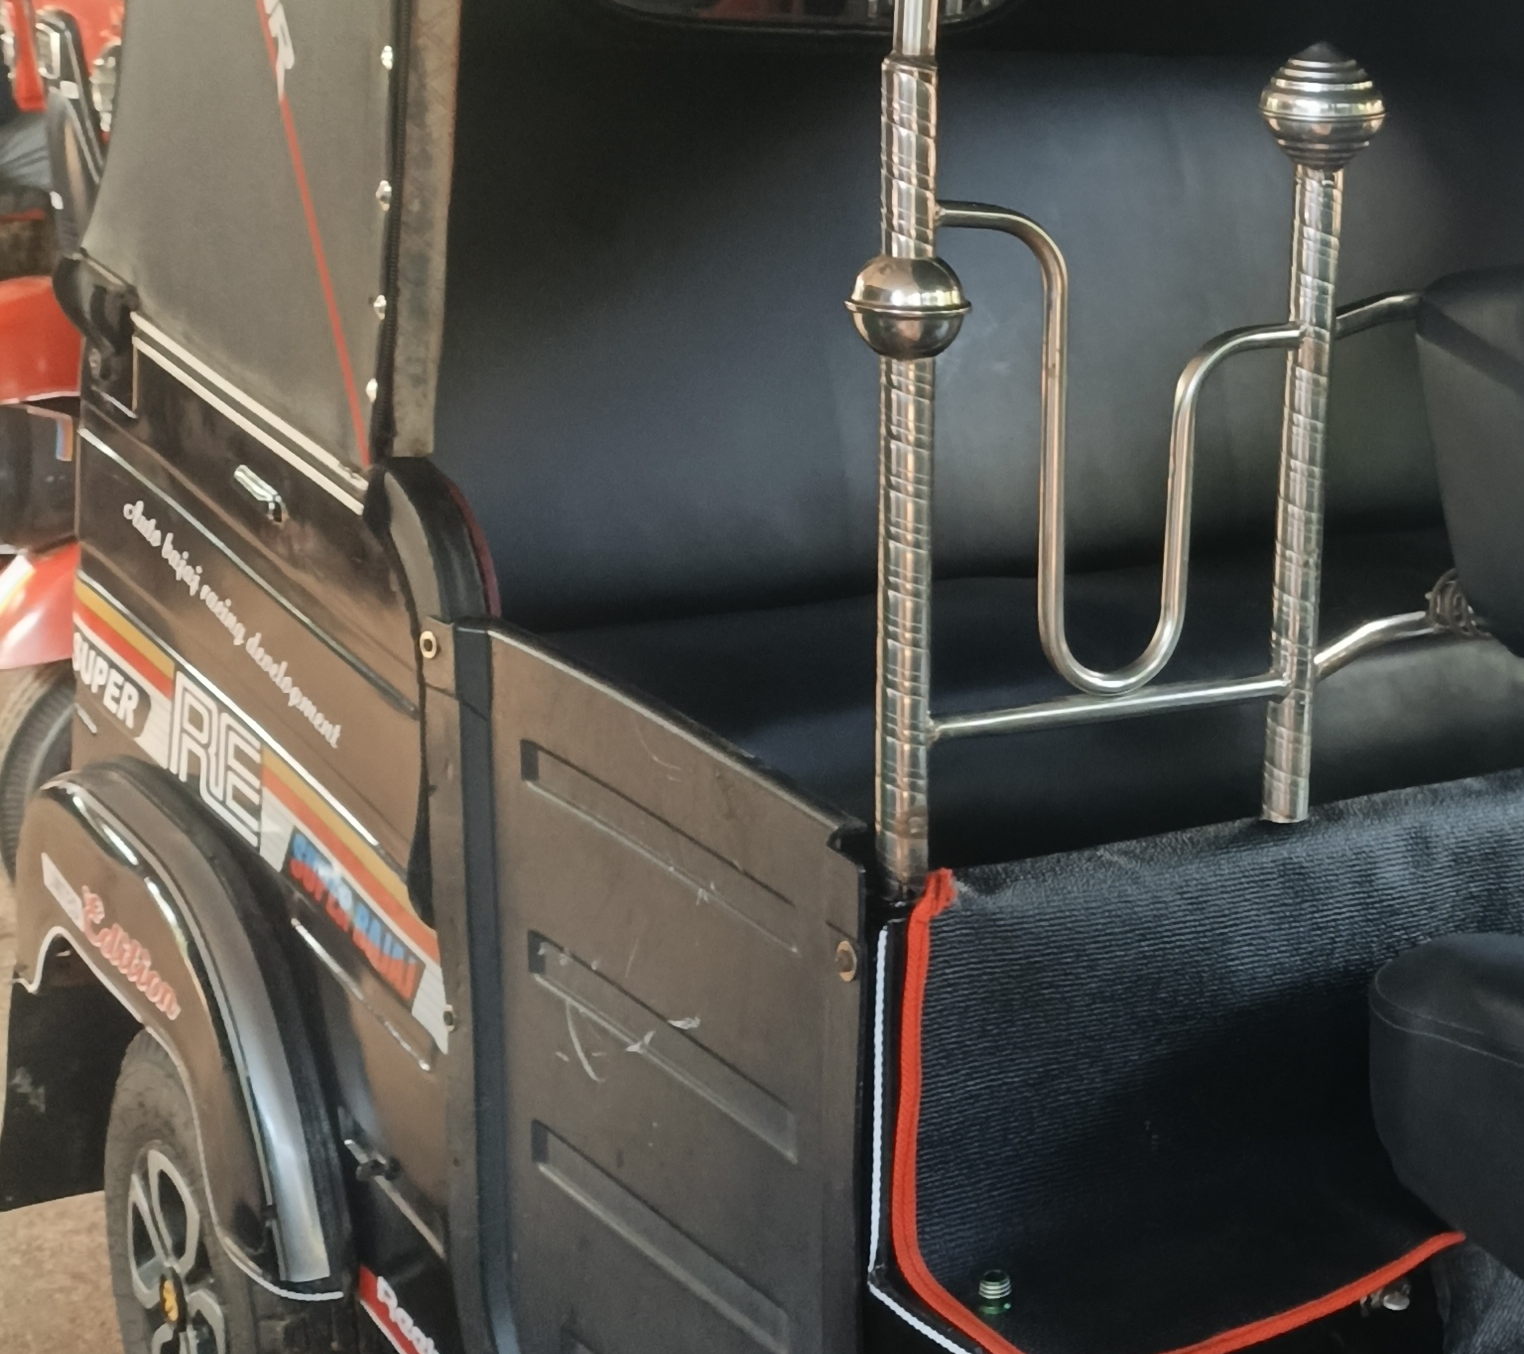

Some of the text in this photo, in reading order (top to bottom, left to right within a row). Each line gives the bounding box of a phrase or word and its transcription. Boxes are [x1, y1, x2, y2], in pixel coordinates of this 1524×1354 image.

[72, 631, 262, 848] SUPER RE
[161, 532, 203, 596] bajaj
[200, 584, 246, 646] racing
[245, 632, 342, 749] development
